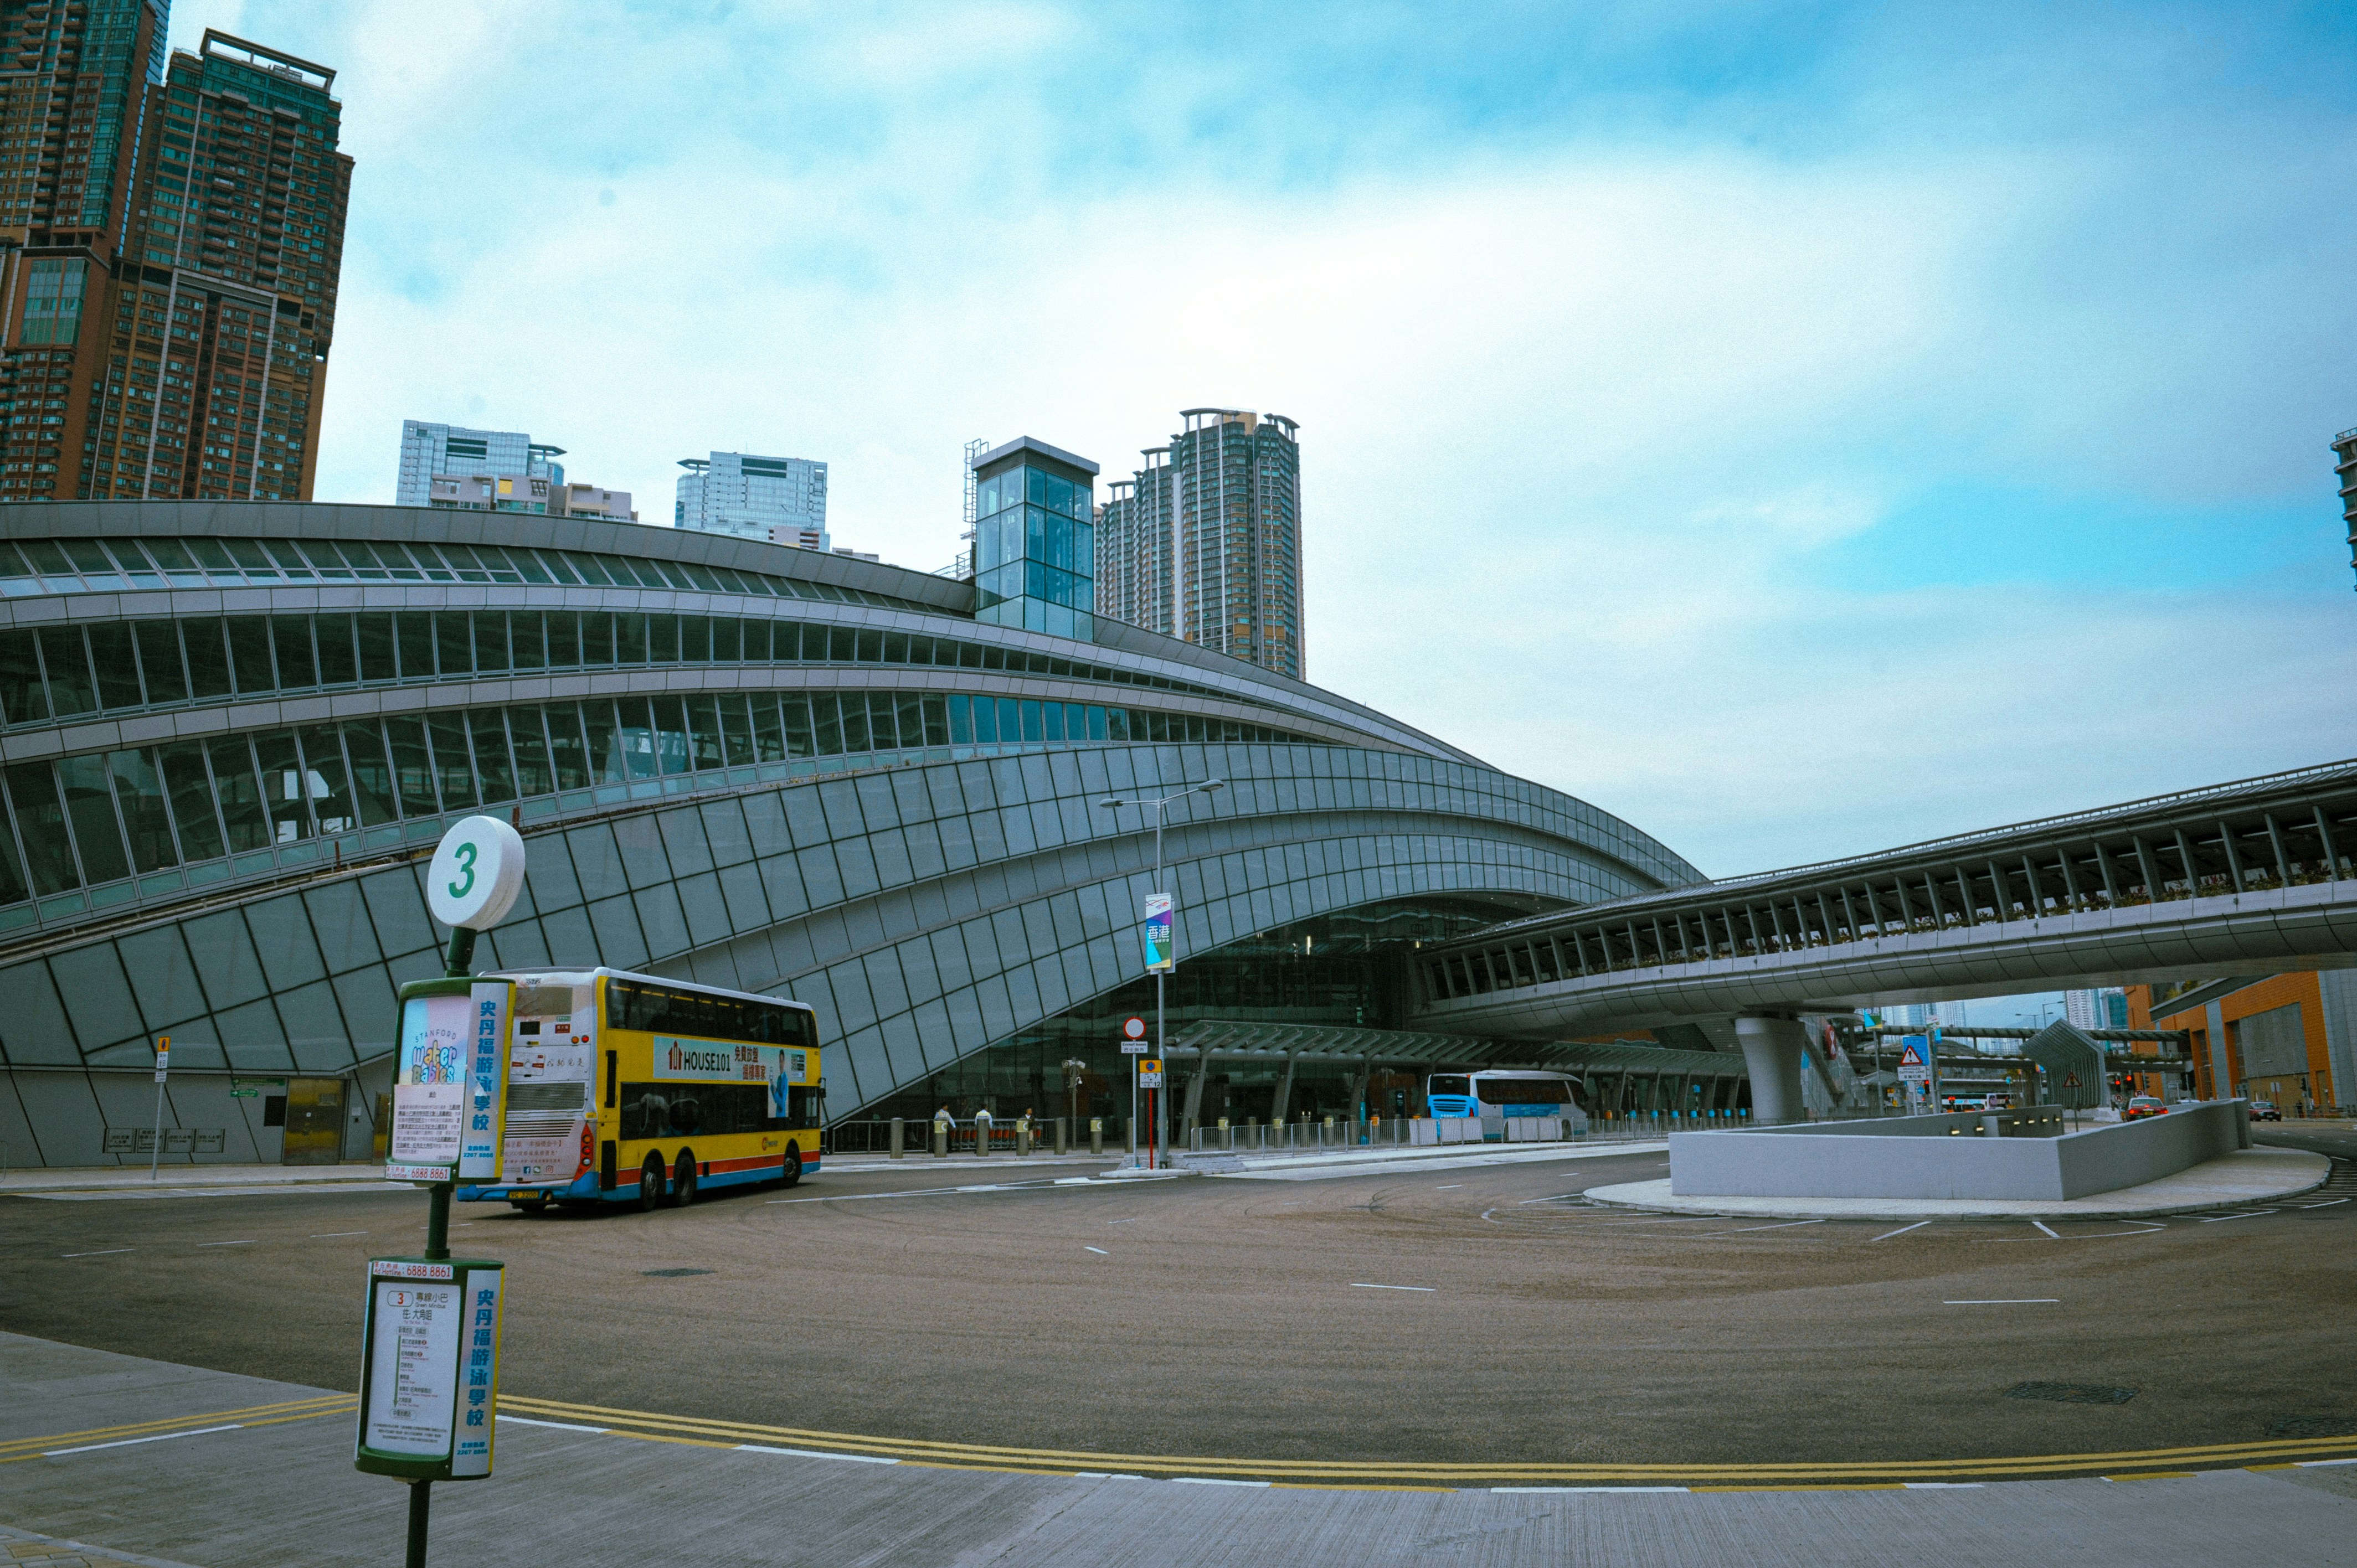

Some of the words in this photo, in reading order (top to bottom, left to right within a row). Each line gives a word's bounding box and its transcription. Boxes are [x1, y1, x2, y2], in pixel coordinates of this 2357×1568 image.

[449, 842, 478, 899] 3
[1147, 925, 1170, 940] 香港
[415, 1029, 456, 1043] STANFORD
[684, 1051, 730, 1072] HOUSE101
[734, 1046, 759, 1063] 免費放盤
[411, 1061, 455, 1085] Babies
[411, 1168, 428, 1178] 6888
[430, 1168, 448, 1179] 8861
[407, 1265, 427, 1276] 6888
[430, 1266, 450, 1277] 8861
[397, 1293, 404, 1304] 3
[416, 1292, 449, 1303] 專線小巴
[413, 1309, 433, 1321] 大角咀
[466, 1289, 495, 1427] 史丹福游泳學校
